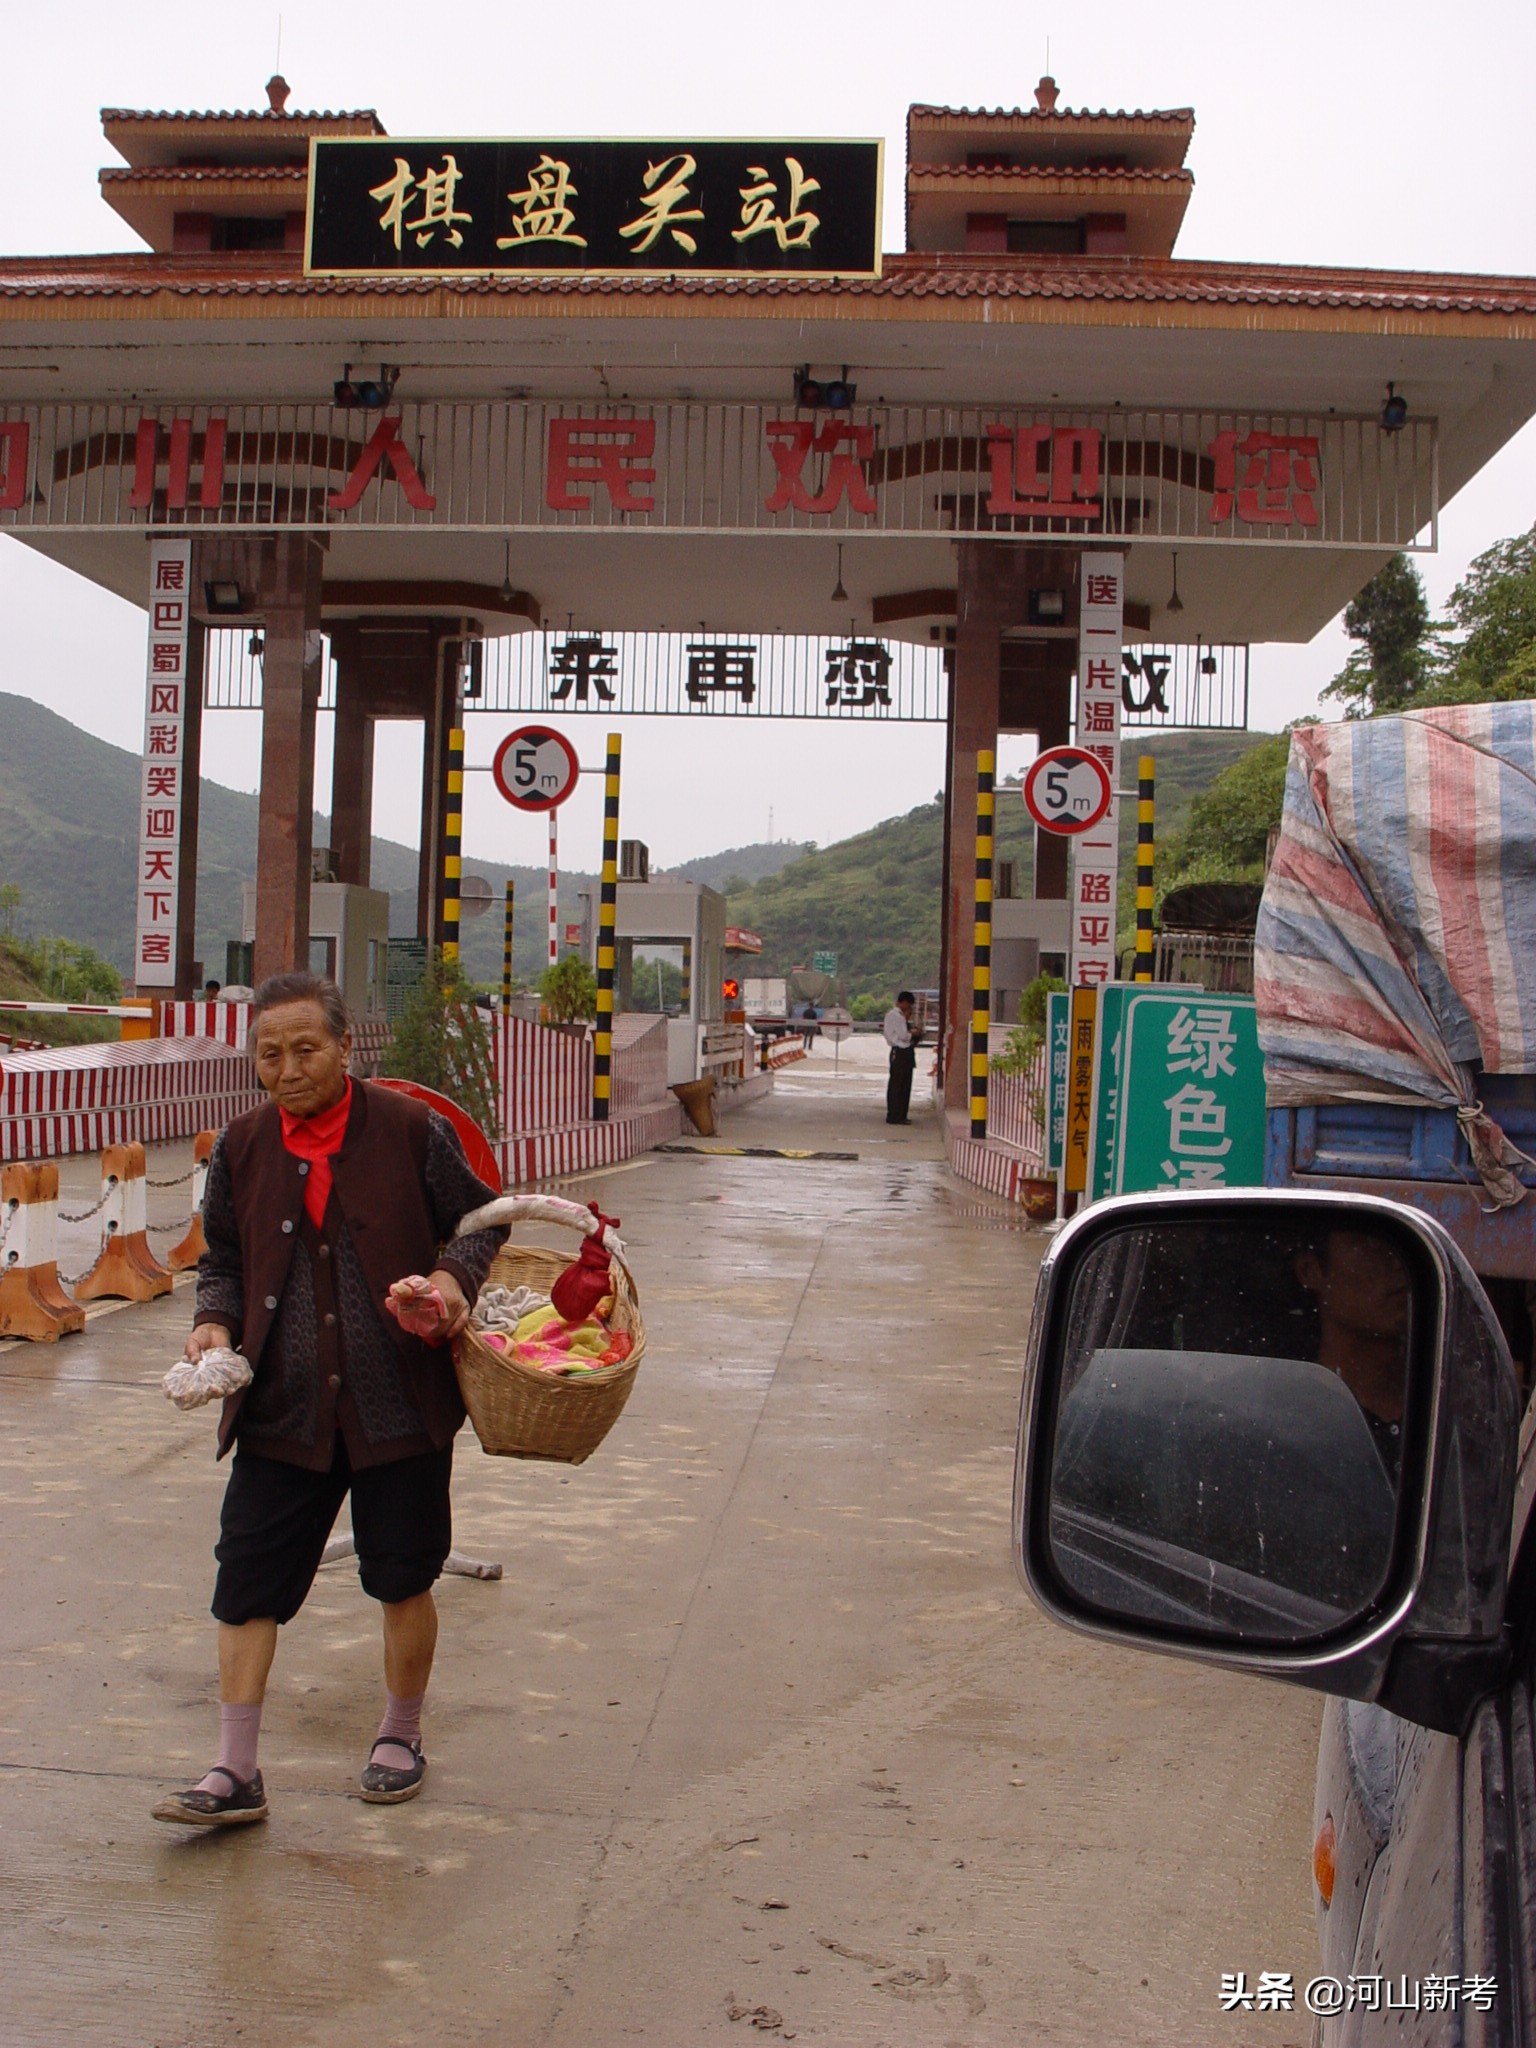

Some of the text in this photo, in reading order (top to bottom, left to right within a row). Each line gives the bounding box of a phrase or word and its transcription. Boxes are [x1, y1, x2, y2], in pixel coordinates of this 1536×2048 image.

[368, 154, 822, 255] 棋盘关站
[141, 559, 185, 964] 展巴蜀风彩笑迎天下客
[1078, 573, 1118, 984] 送一片温一路平安
[1072, 1019, 1093, 1158] 雨雾天气
